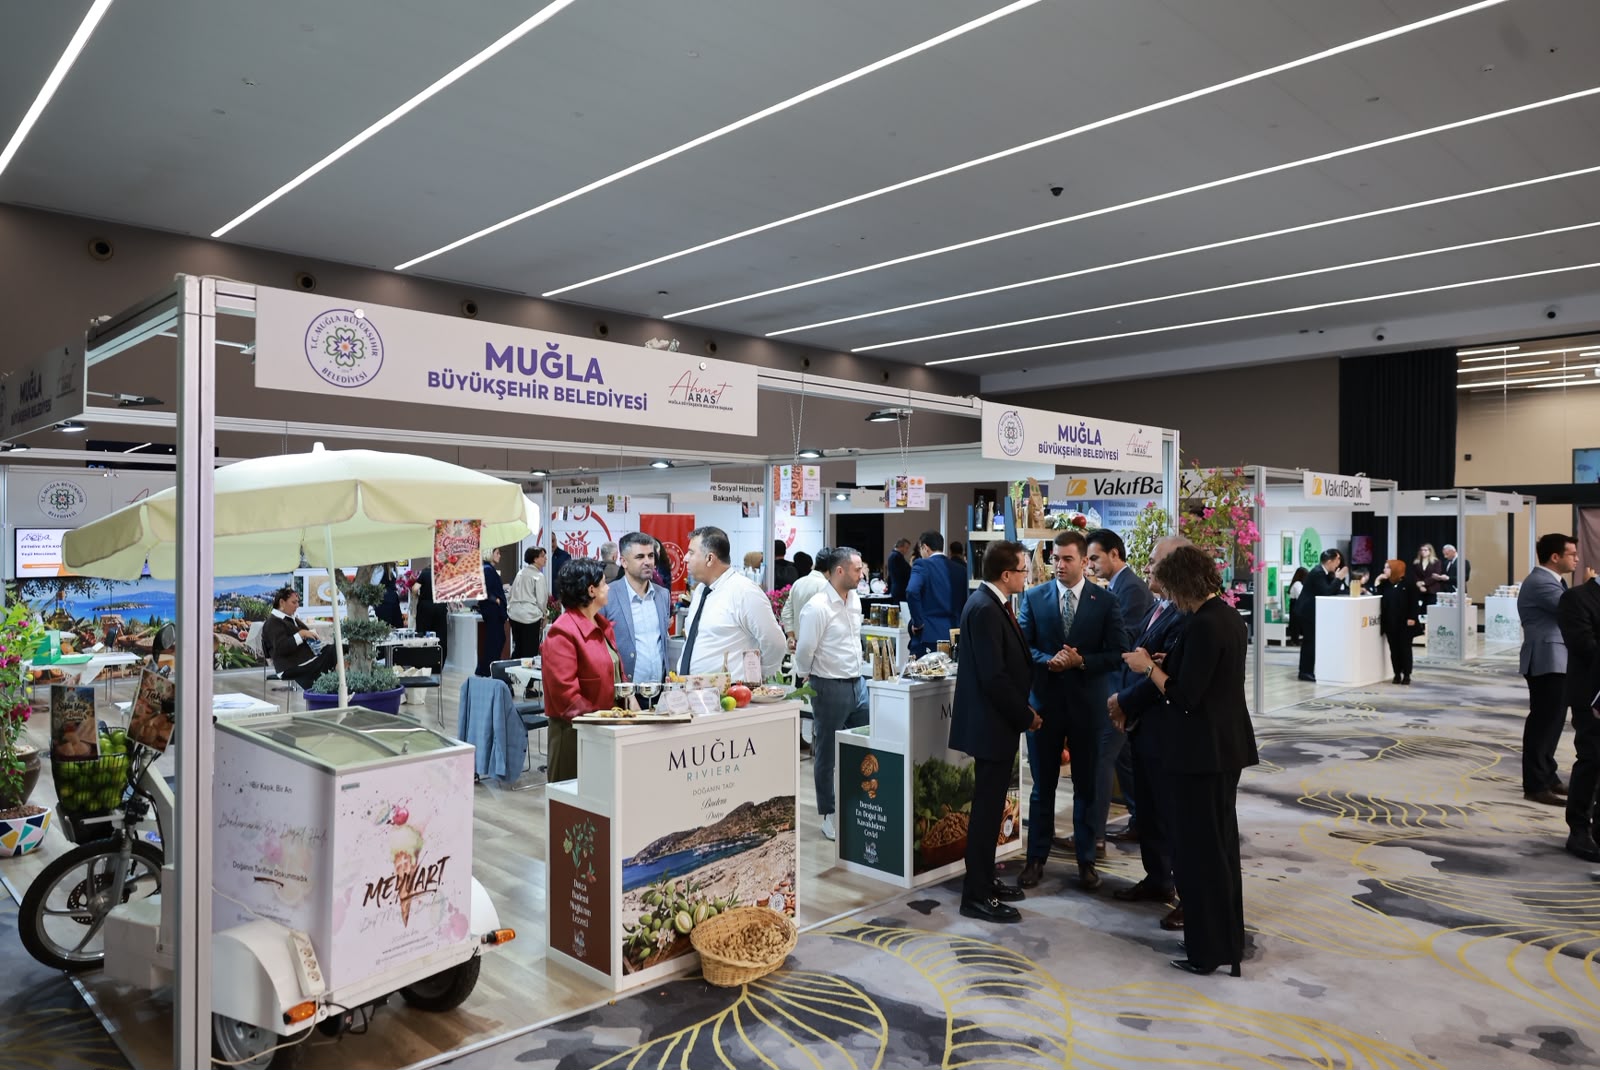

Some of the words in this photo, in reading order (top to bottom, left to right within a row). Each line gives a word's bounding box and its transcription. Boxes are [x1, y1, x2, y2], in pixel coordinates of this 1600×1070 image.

[485, 342, 604, 385] MUĞLA
[321, 367, 368, 384] BELEDİYESİ
[428, 368, 549, 400] BÜYÜKŞEHİR
[554, 388, 648, 412] BELEDİYESİ
[668, 370, 734, 405] Ahmet
[688, 392, 716, 405] ARAS
[1058, 422, 1102, 446] MUĞLA
[1038, 441, 1082, 460] BÜYÜKŞEHİR
[1083, 449, 1119, 461] BELEDİYESİ
[577, 485, 590, 495] Sosyal
[717, 484, 738, 494] Sosyal
[1324, 479, 1363, 498] VakıfBank
[668, 737, 757, 771] MUĞLA
[686, 763, 741, 782] RIVIERA
[251, 781, 259, 790] Bir
[276, 784, 284, 792] Bir
[284, 786, 293, 794] An
[692, 784, 721, 796] DOĞANIN
[700, 797, 727, 810] Badem
[859, 800, 883, 813] Bereketin
[855, 809, 863, 817] En
[863, 810, 877, 822] Doğal
[877, 813, 888, 823] Hali
[856, 818, 886, 832] Kavaklıdere
[863, 829, 879, 840] Cevizi
[254, 864, 273, 876] Tarifine
[362, 854, 451, 908] MEYVART
[572, 912, 589, 928] Lezzeti
